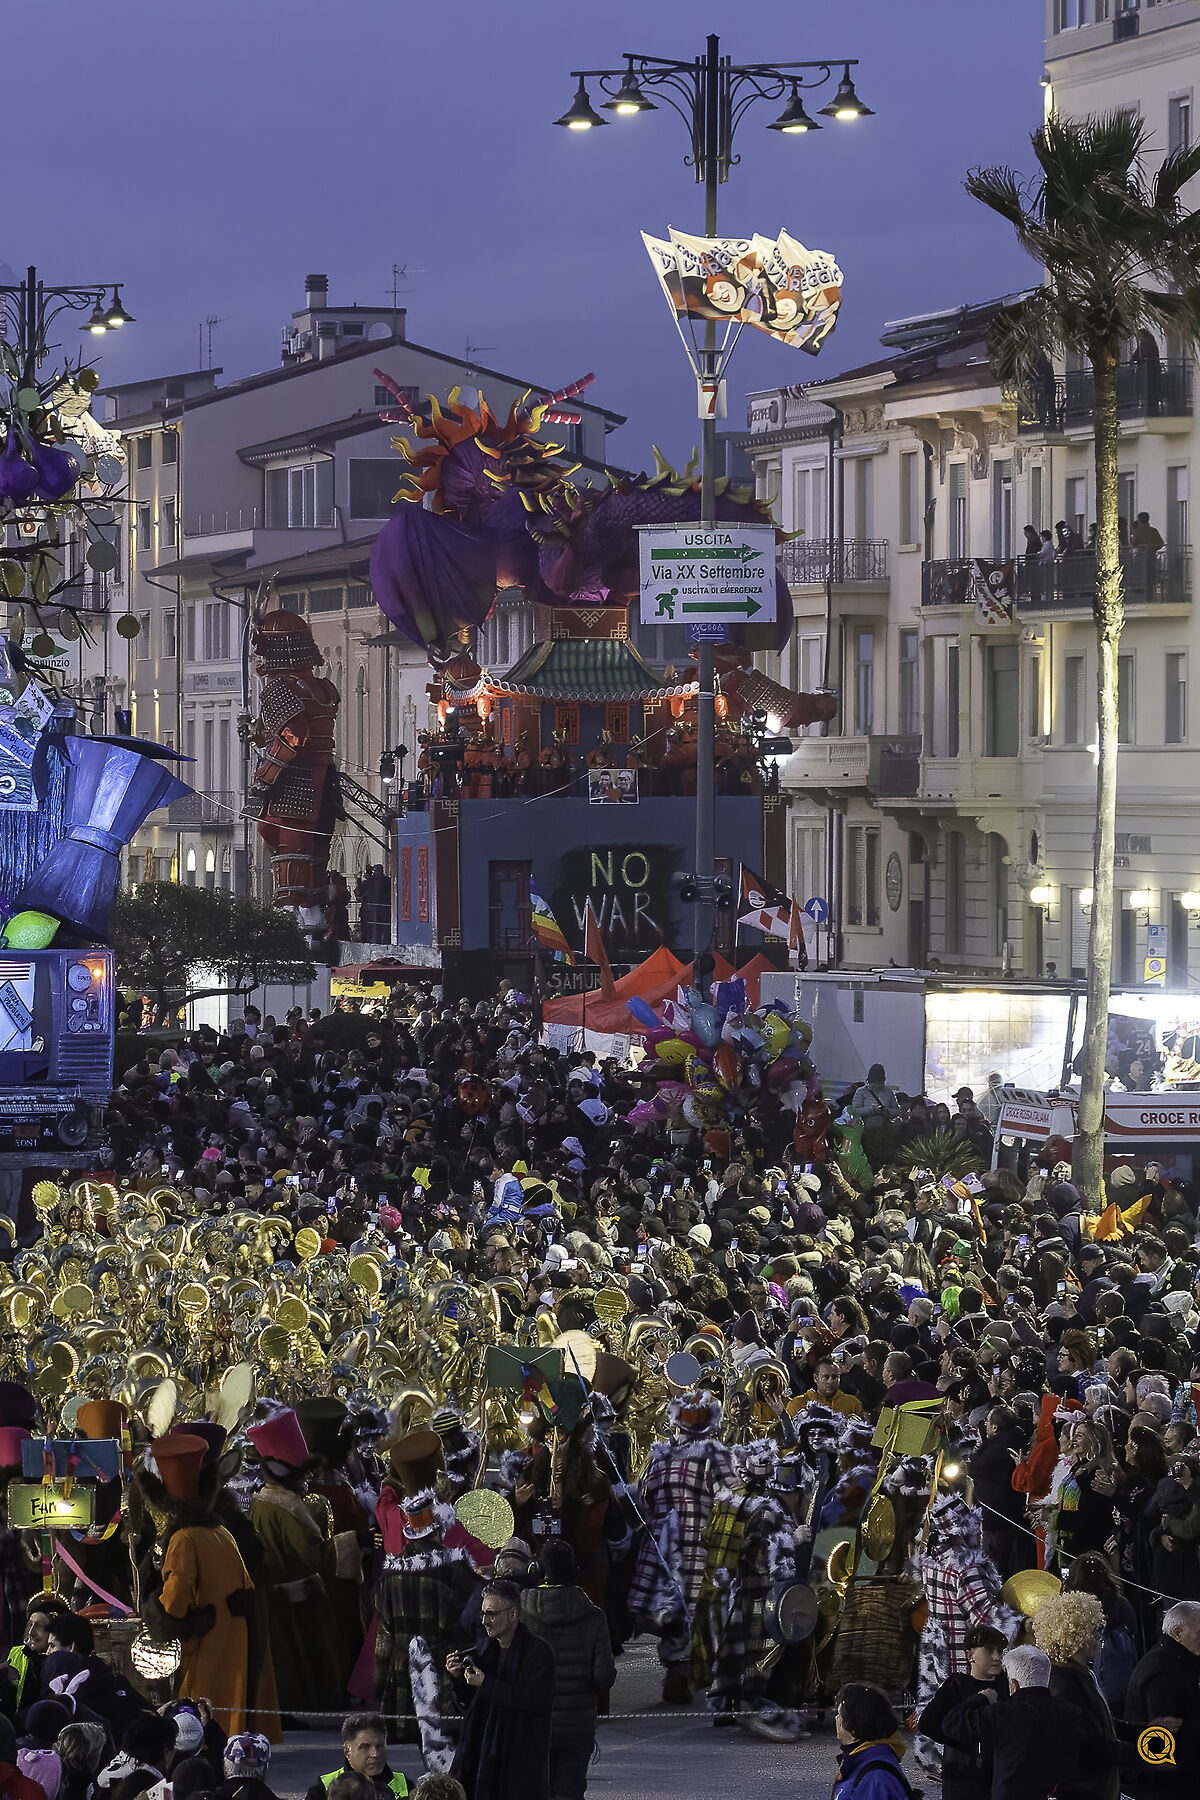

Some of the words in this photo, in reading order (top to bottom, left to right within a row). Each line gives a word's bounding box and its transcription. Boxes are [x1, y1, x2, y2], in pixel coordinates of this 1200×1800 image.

[702, 385, 718, 413] 7
[684, 534, 733, 546] USCITA
[652, 565, 673, 580] Via
[677, 565, 696, 579] XX
[700, 563, 765, 579] Settembre
[682, 586, 709, 595] USCITA
[711, 586, 719, 594] DI
[720, 585, 763, 594] EMERGENZA
[591, 851, 649, 888] NO
[570, 892, 665, 934] WAR
[1005, 1106, 1020, 1118] CROCE
[1019, 1109, 1034, 1120] ROSSA
[1140, 1112, 1185, 1125] CROCE
[1189, 1113, 1200, 1125] R
